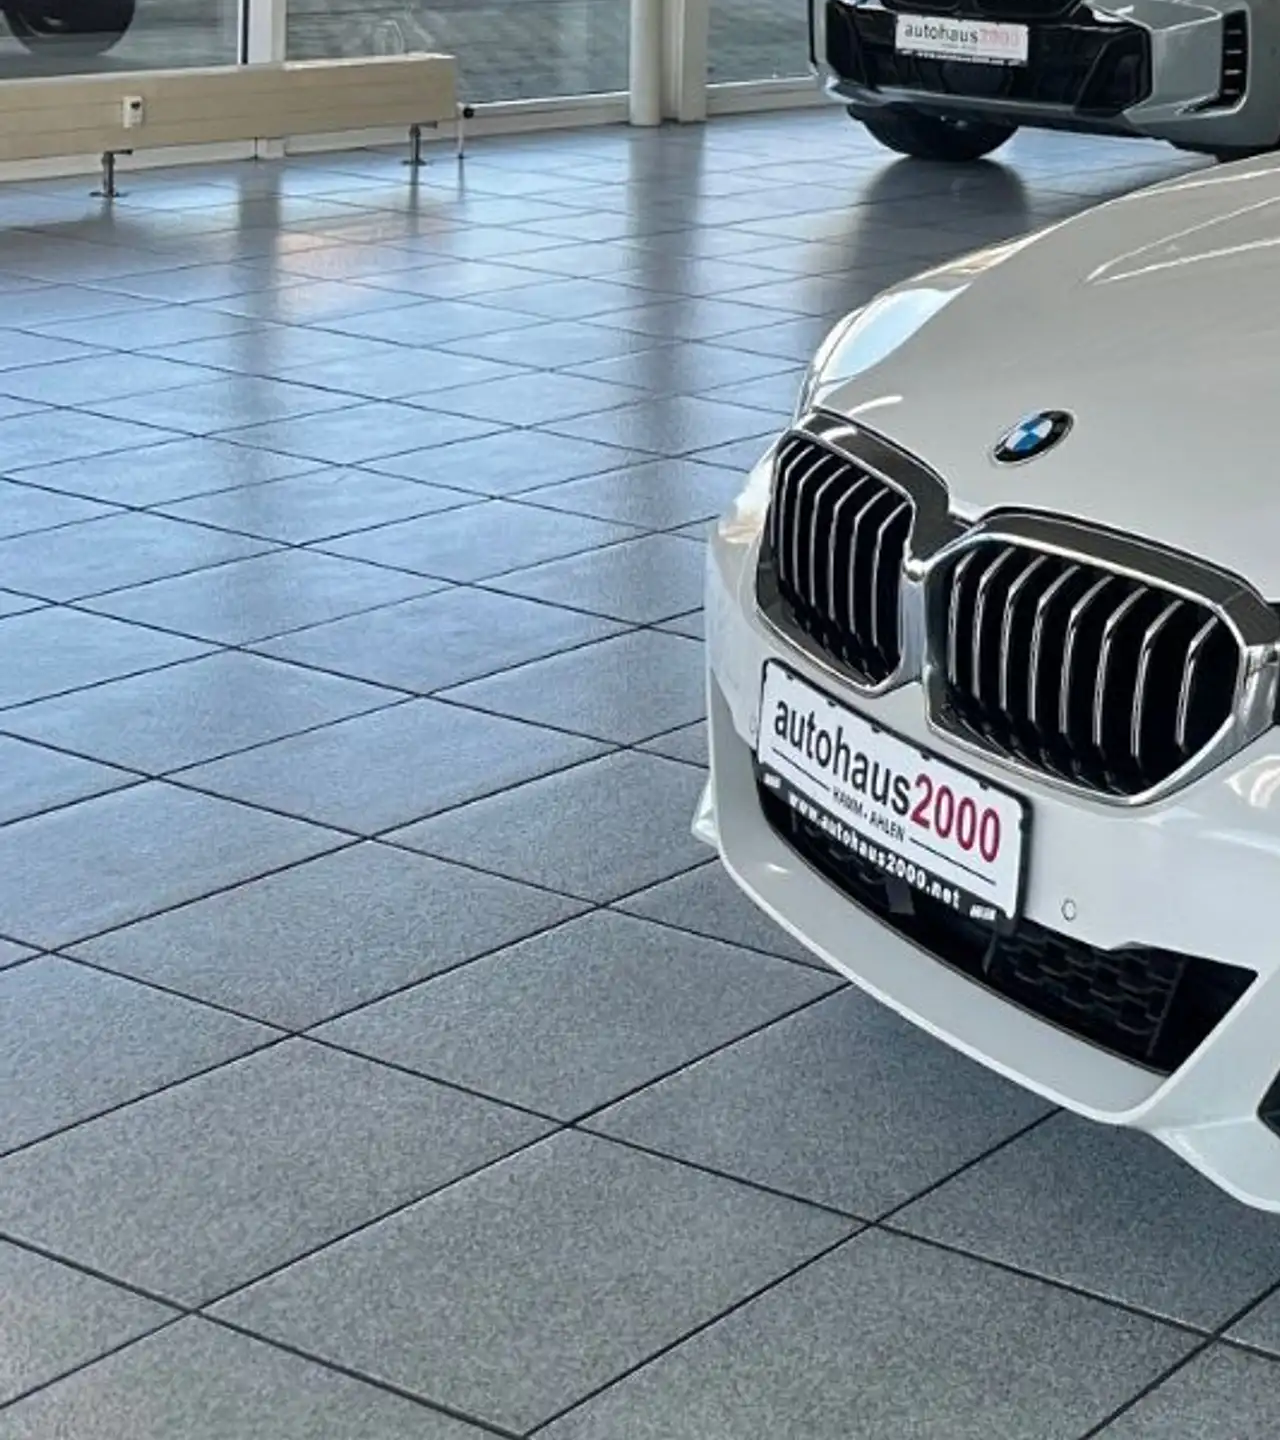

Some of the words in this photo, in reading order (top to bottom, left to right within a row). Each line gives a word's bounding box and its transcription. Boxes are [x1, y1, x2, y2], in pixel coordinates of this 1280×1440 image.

[904, 23, 1020, 48] autohaus2000
[774, 700, 1000, 863] autohaus2000
[869, 811, 905, 842] AHLEN
